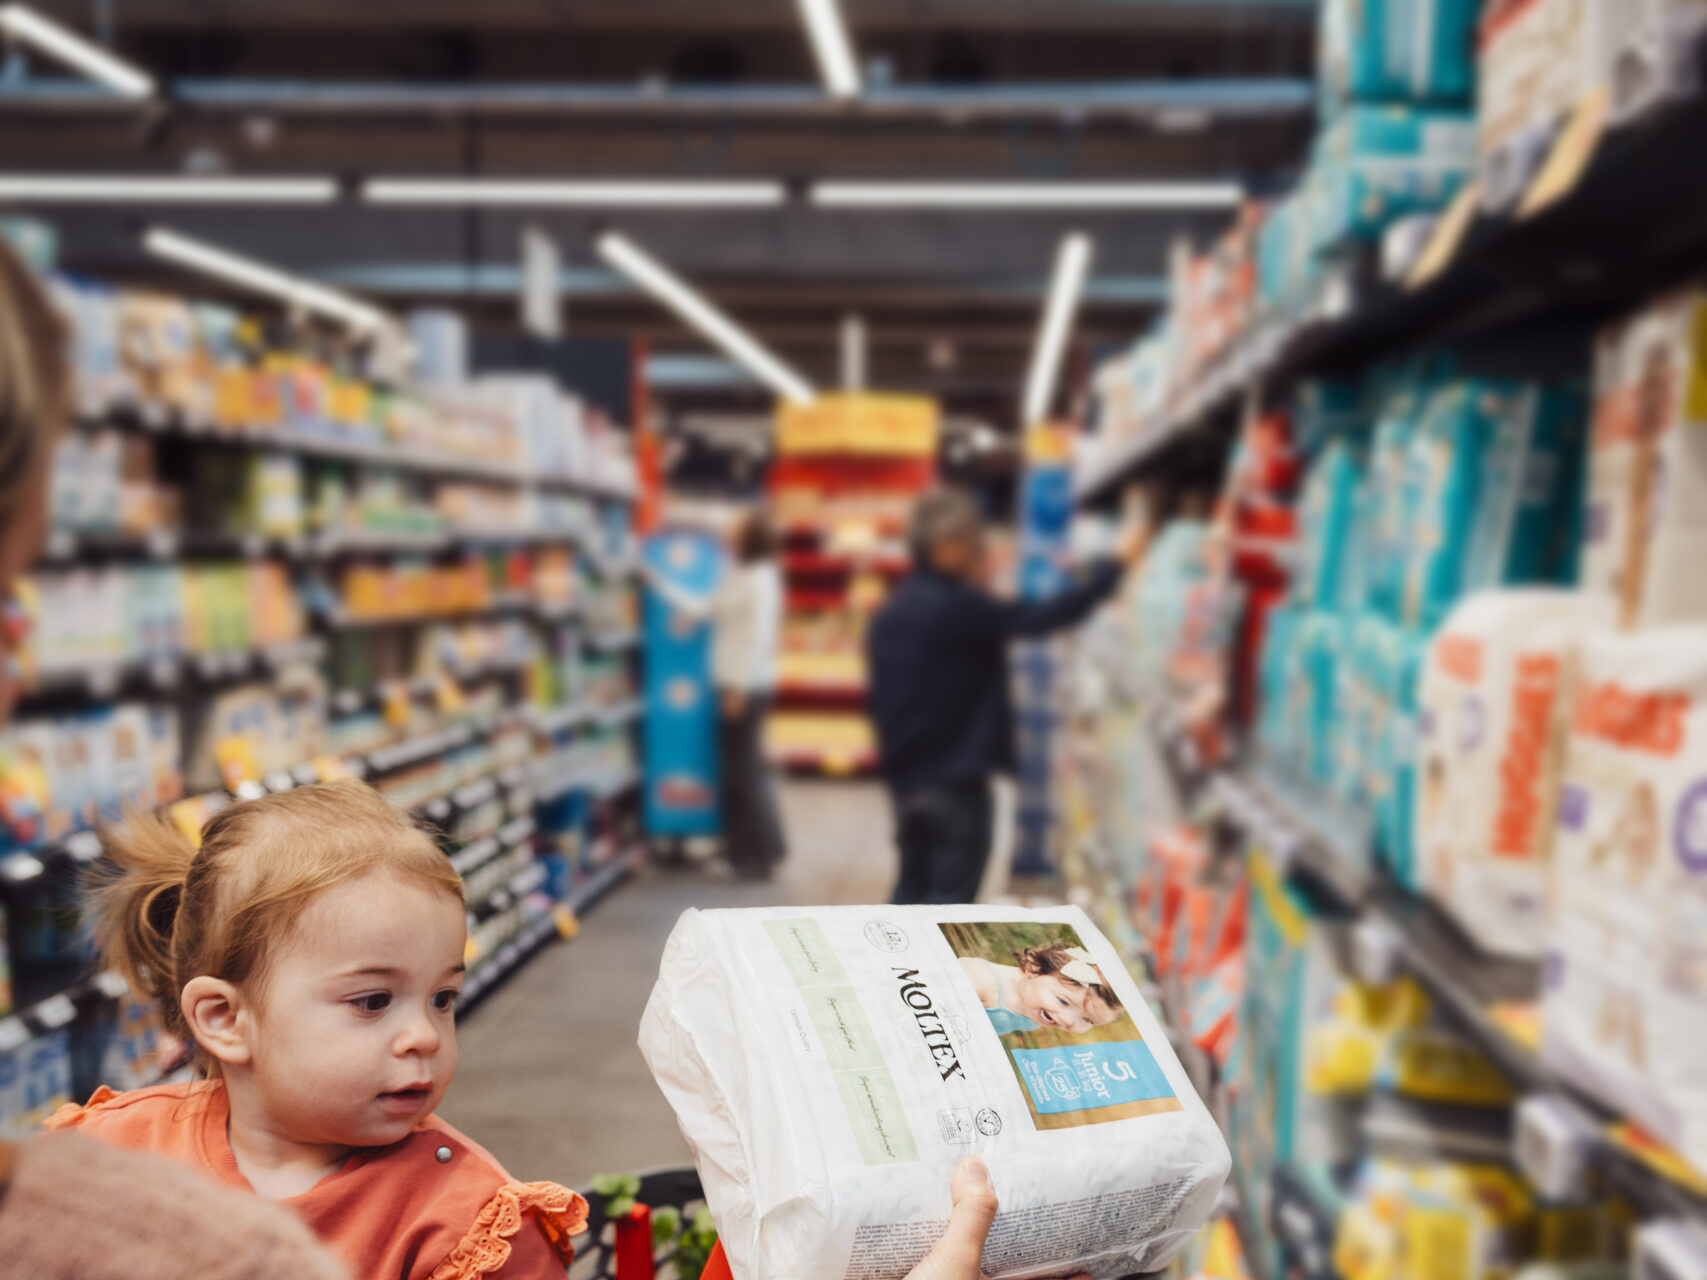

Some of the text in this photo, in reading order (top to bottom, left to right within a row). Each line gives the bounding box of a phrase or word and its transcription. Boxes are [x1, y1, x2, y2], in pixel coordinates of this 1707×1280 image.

[891, 967, 966, 1082] MOLTEX
[1051, 1074, 1068, 1092] 25
[1073, 1051, 1111, 1098] Junior
[1102, 1061, 1137, 1081] 5
